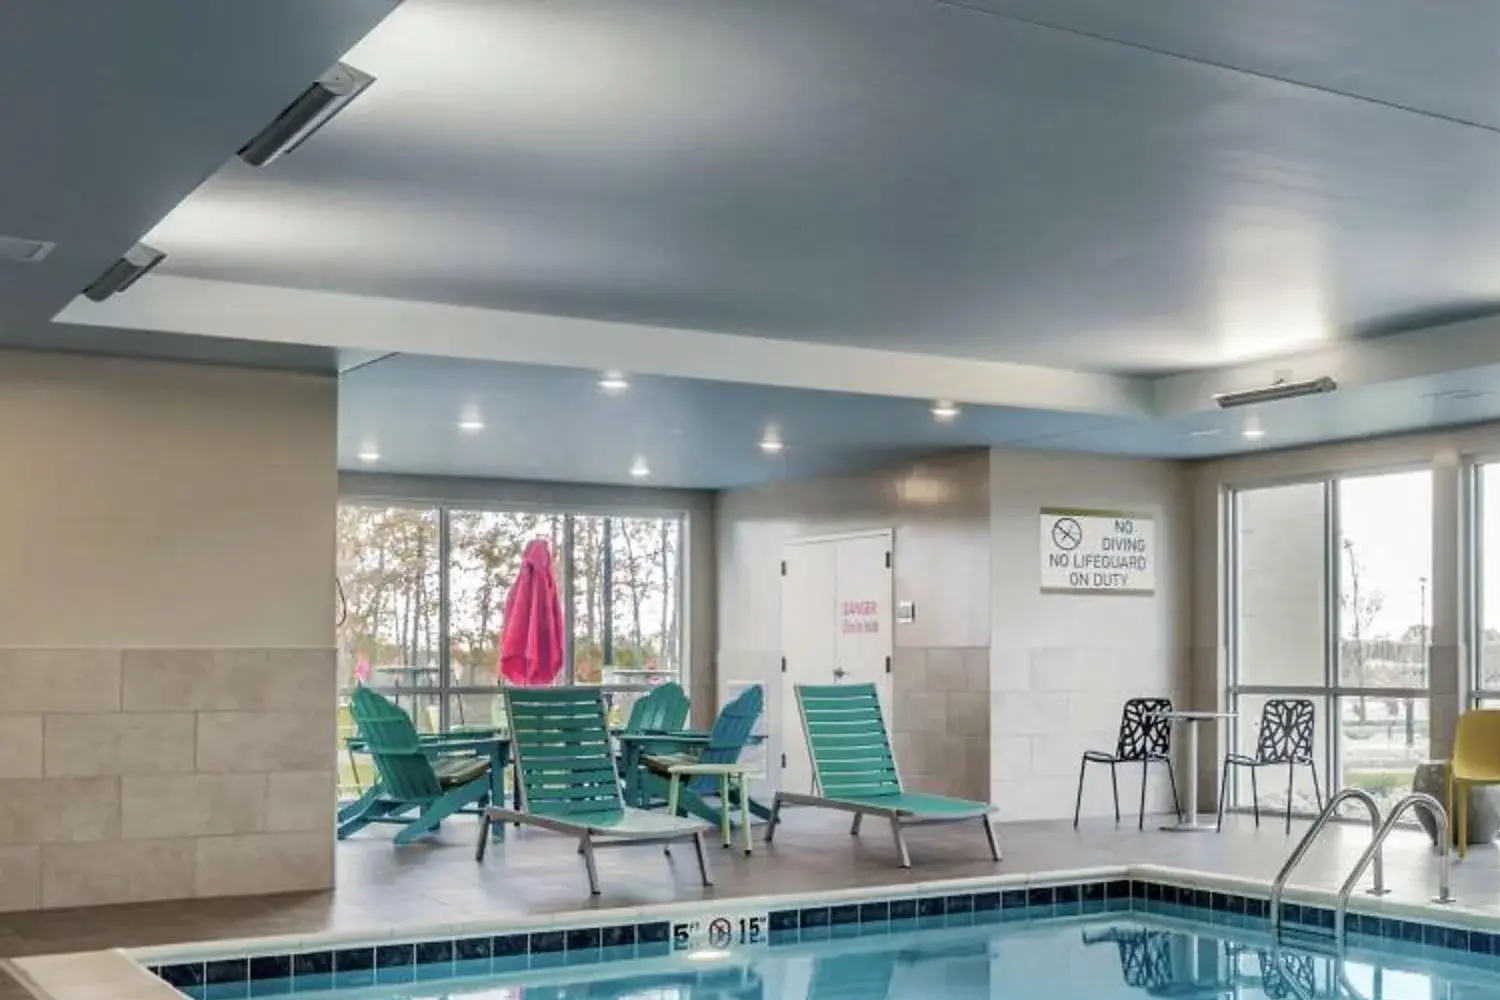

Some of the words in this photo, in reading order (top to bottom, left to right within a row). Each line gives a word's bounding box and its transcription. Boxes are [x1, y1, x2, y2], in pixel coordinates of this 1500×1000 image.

[1114, 519, 1133, 534] NO
[1102, 537, 1145, 552] DIVING
[1049, 553, 1069, 567] NO
[1073, 554, 1147, 570] LIFEGUARD
[1069, 572, 1089, 586] ON
[1093, 572, 1129, 587] DUTY
